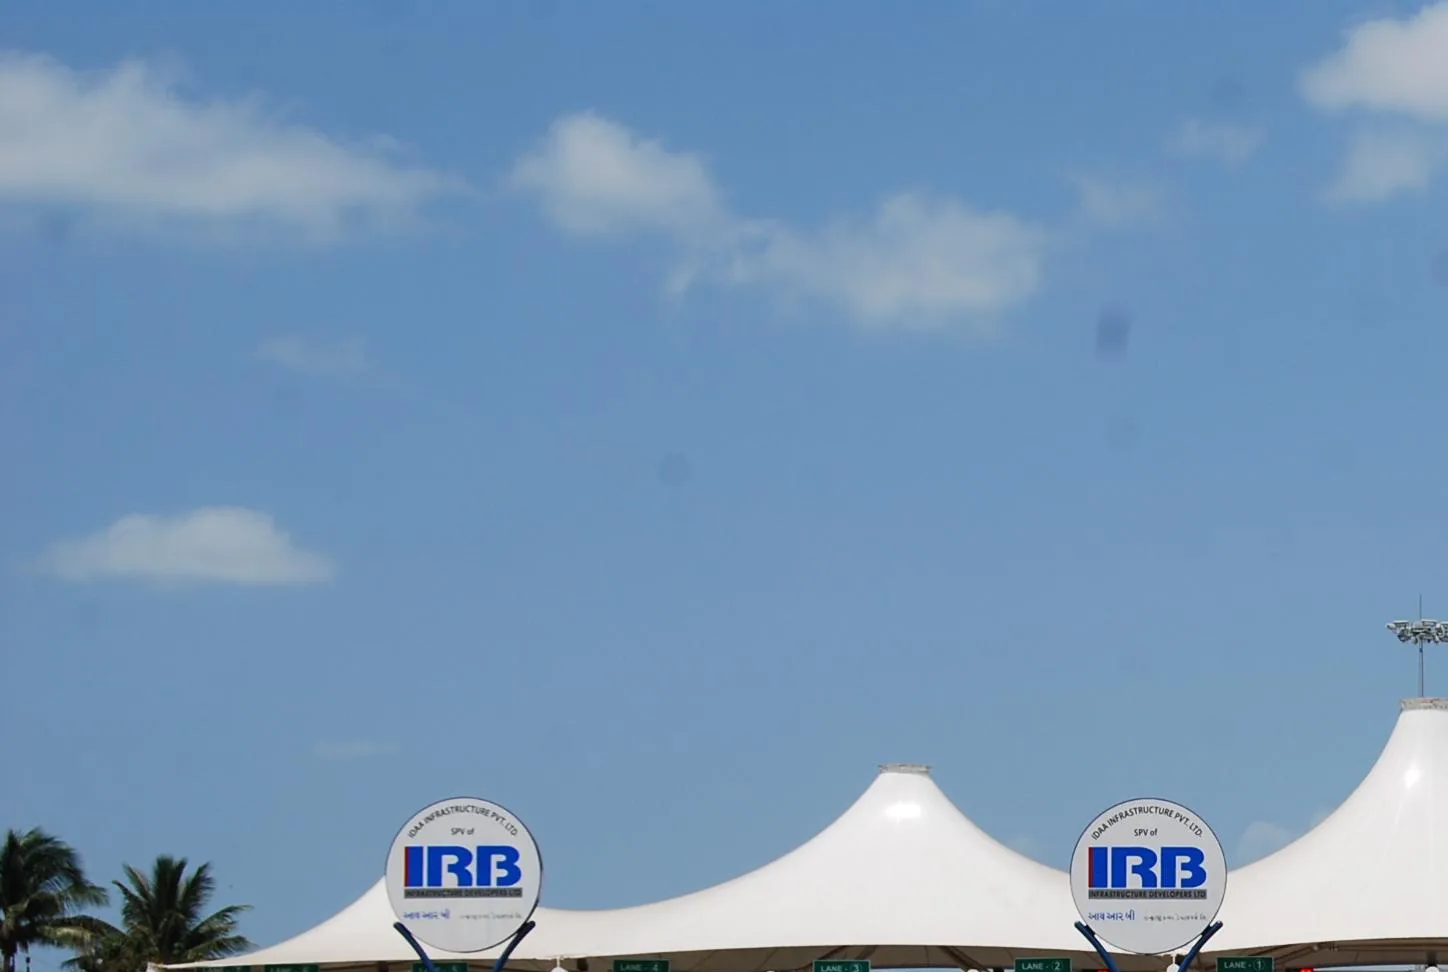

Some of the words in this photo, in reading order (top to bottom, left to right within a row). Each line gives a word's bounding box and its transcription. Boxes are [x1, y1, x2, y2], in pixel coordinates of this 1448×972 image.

[408, 822, 424, 838] IDAA
[424, 804, 489, 824] INFRASTRUCTURE
[490, 811, 506, 825] PVT.
[450, 828, 465, 836] SPV
[466, 827, 475, 836] of
[1092, 822, 1108, 840] IDAA
[1108, 805, 1174, 826] INFRASTRUCTURE
[1174, 812, 1190, 826] PVT.
[1134, 828, 1148, 837] SPV
[1150, 828, 1158, 837] of
[404, 846, 522, 888] IRB
[1088, 846, 1207, 888] IRB
[1089, 890, 1148, 899] INFRASTRUCTURE
[1149, 890, 1192, 899] DEVELOPERS
[1193, 890, 1206, 899] LTD
